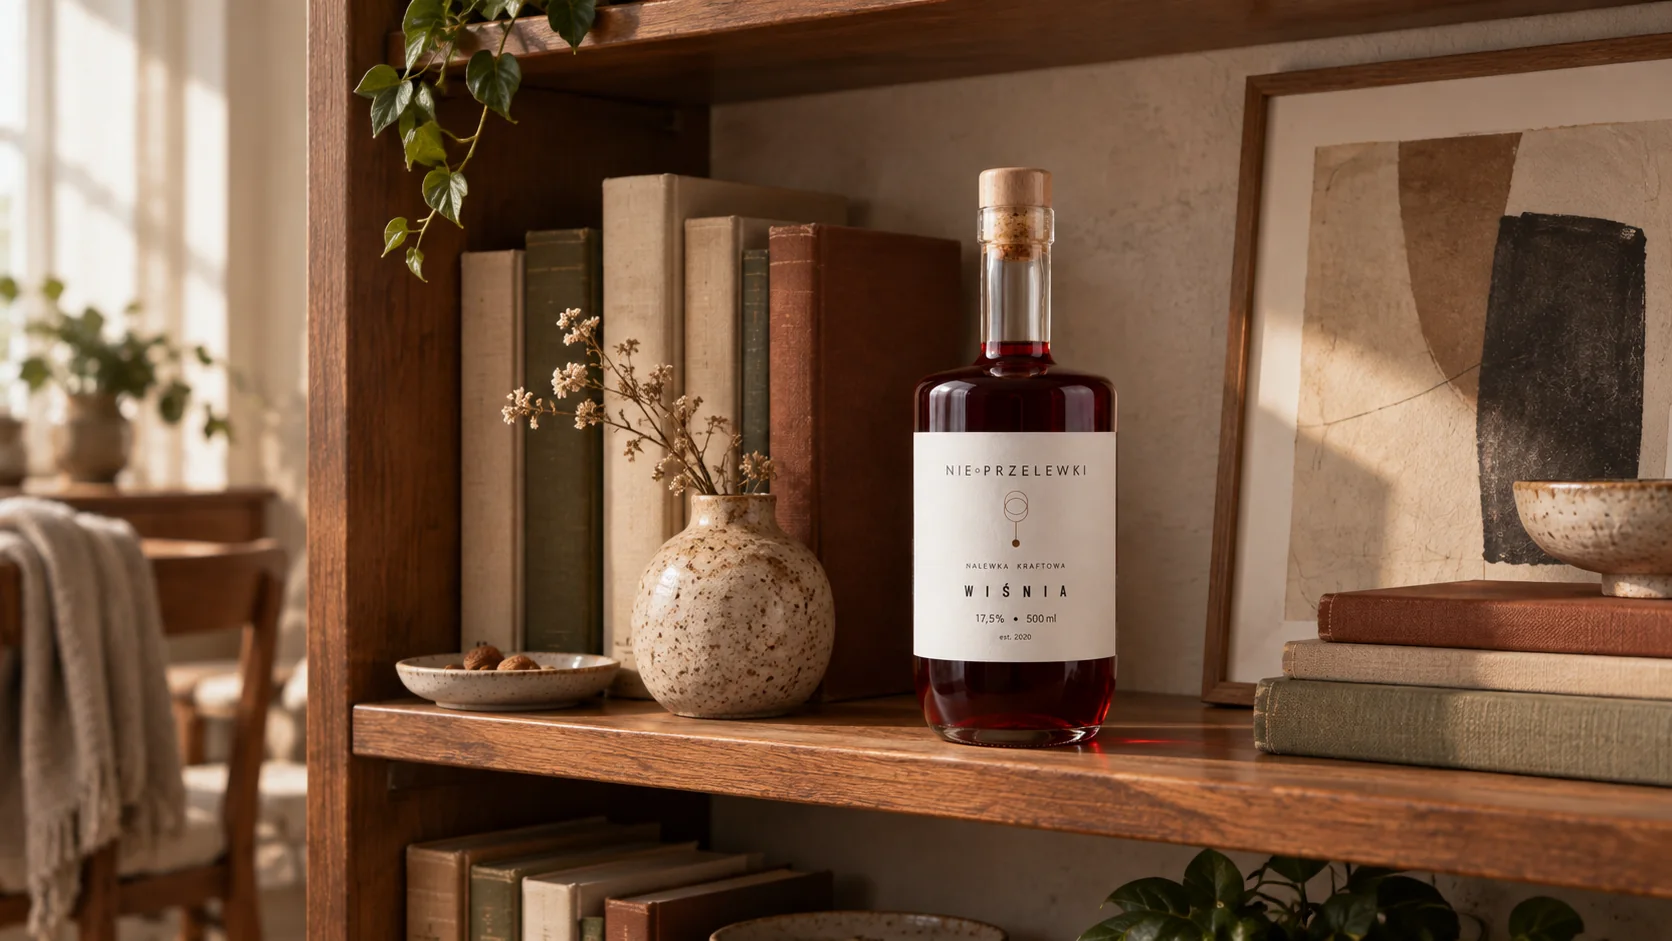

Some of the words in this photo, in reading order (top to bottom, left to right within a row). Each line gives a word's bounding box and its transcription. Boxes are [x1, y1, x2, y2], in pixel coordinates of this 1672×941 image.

[965, 562, 1009, 570] NALEWKA
[1016, 562, 1066, 570] KRAFTOWA
[964, 582, 1067, 598] WIŚNIA
[975, 613, 1005, 625] 17,5%
[1026, 613, 1045, 624] 500
[999, 633, 1012, 641] est.
[1014, 633, 1032, 641] 2020
